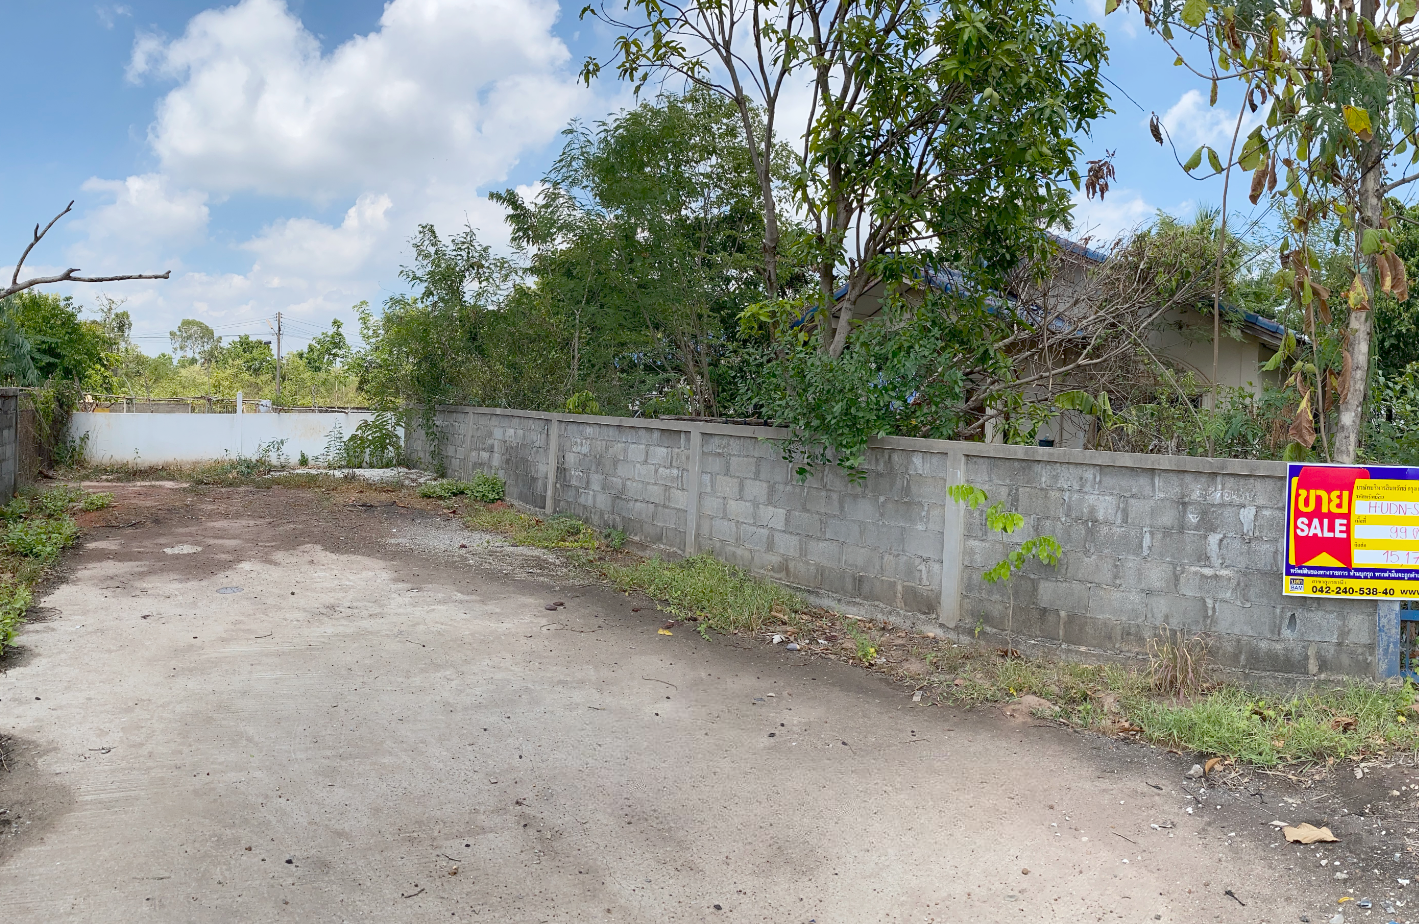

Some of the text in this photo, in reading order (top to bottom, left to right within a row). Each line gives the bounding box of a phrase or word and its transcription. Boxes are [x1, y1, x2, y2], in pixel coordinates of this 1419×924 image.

[1298, 489, 1349, 513] ขาย
[1296, 517, 1347, 538] SALE
[1390, 526, 1407, 539] 99
[1311, 586, 1395, 596] 042-240-538-40
